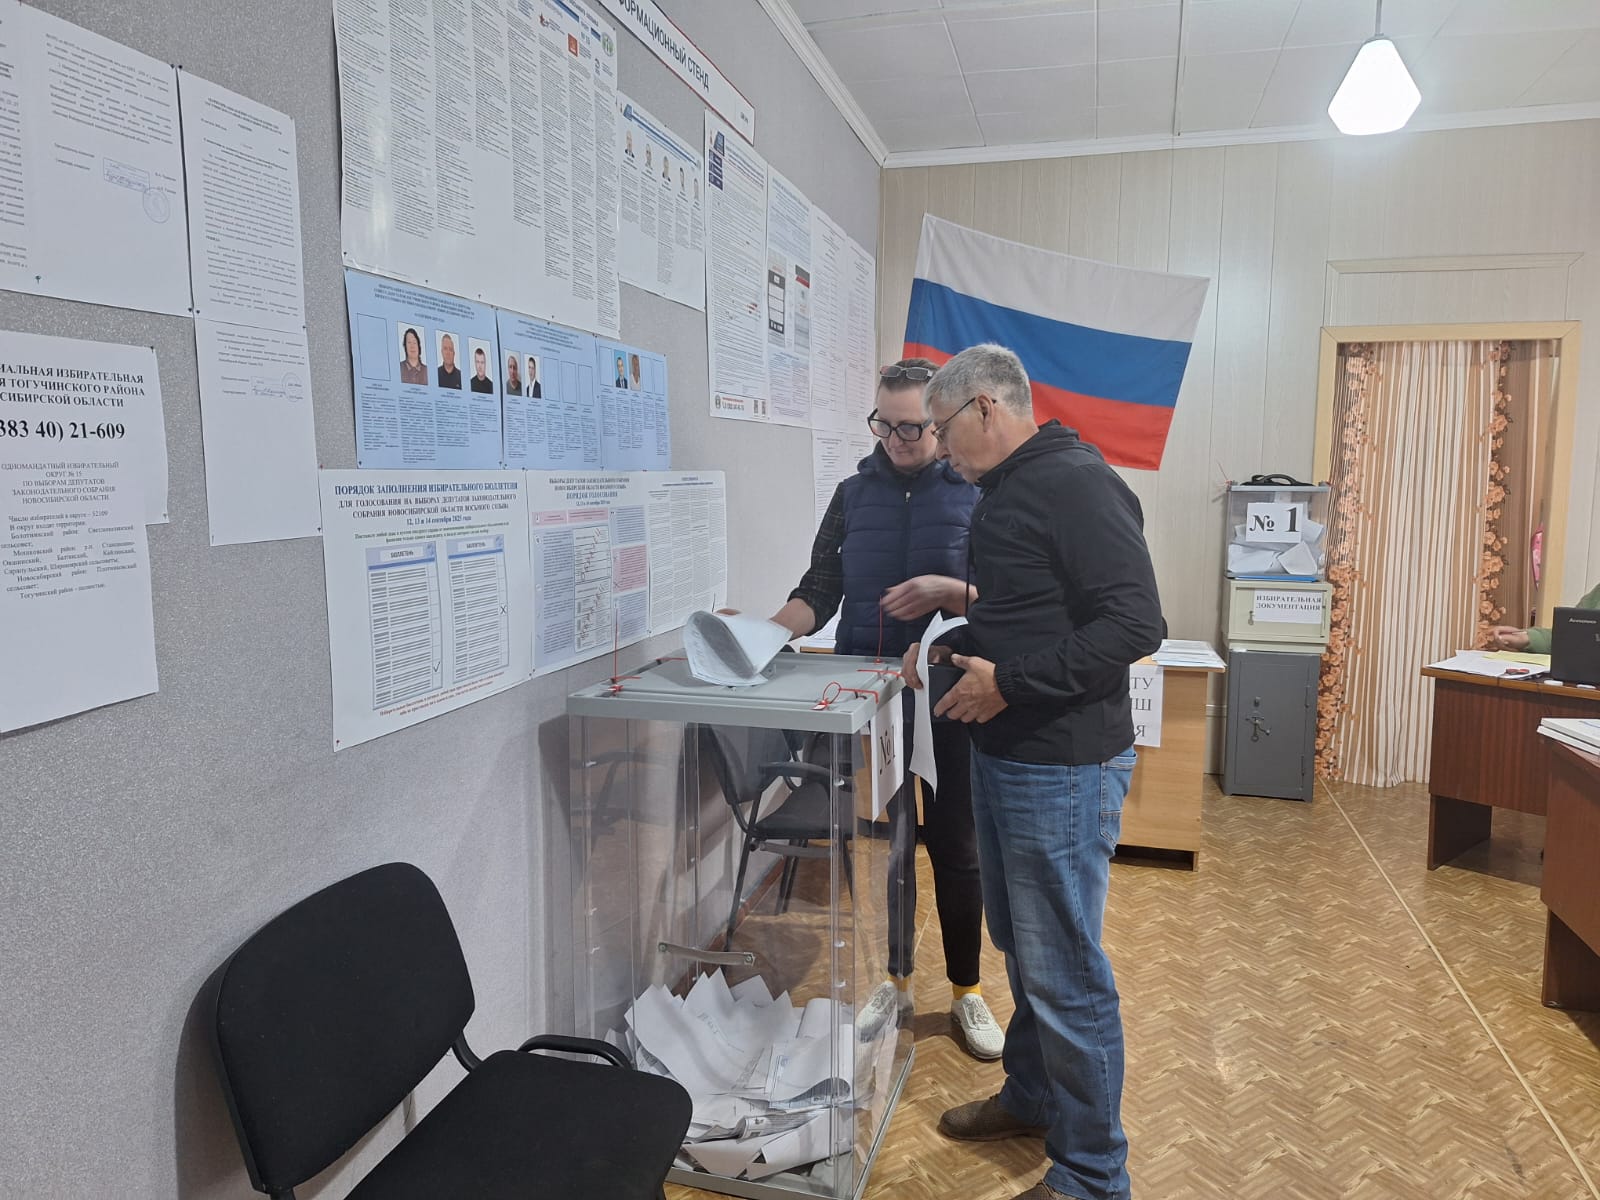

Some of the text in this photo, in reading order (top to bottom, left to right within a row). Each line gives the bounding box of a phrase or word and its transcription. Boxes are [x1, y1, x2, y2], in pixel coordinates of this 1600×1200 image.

[687, 57, 710, 93] СТЕНД
[56, 368, 144, 384] ИЗБИРАТЕЛЬНАЯ
[10, 379, 102, 394] ТОГУЧИНСКОГО
[103, 384, 145, 396] РАЙОНА
[0, 391, 124, 407] СИБИРСКОЙ ОБЛАСТИ
[35, 420, 64, 442] 40)
[69, 421, 125, 439] 21-609
[1, 461, 119, 471] ОДНОМАНДАТНЫЙ ИЗБИРАТЕЛЬНЫЙ
[34, 479, 66, 487] ВЫБОРАМ
[67, 478, 105, 486] ДЕПУТАТОВ
[334, 482, 518, 496] ПОРЯДОК ЗАПОЛНЕНИЯ ИЗБИРАТЕЛЬНОГО БЮЛЛЕТЕНЯ
[12, 486, 116, 496] ЗАКОНОДАТЕЛЬНОГО СОБРАНИЯ
[22, 494, 109, 505] НОВОСИБИРСКОЙ ОБЛАСТИ
[338, 500, 353, 509] ДЛЯ
[355, 498, 402, 508] ГОЛОСОВАНИЯ
[403, 497, 413, 505] НА
[414, 496, 440, 505] ВЫБОРАХ
[352, 510, 386, 519] СОБРАНИЯ
[387, 506, 440, 517] НОВОСИБИРСКОЙ
[440, 505, 464, 514] ОБЛАСТИ
[1249, 506, 1300, 533] № 1
[1256, 595, 1322, 603] ИЗБИРАТЕЛЬНАЯ
[1255, 602, 1321, 611] ДОКУМЕНТАЦИЯ
